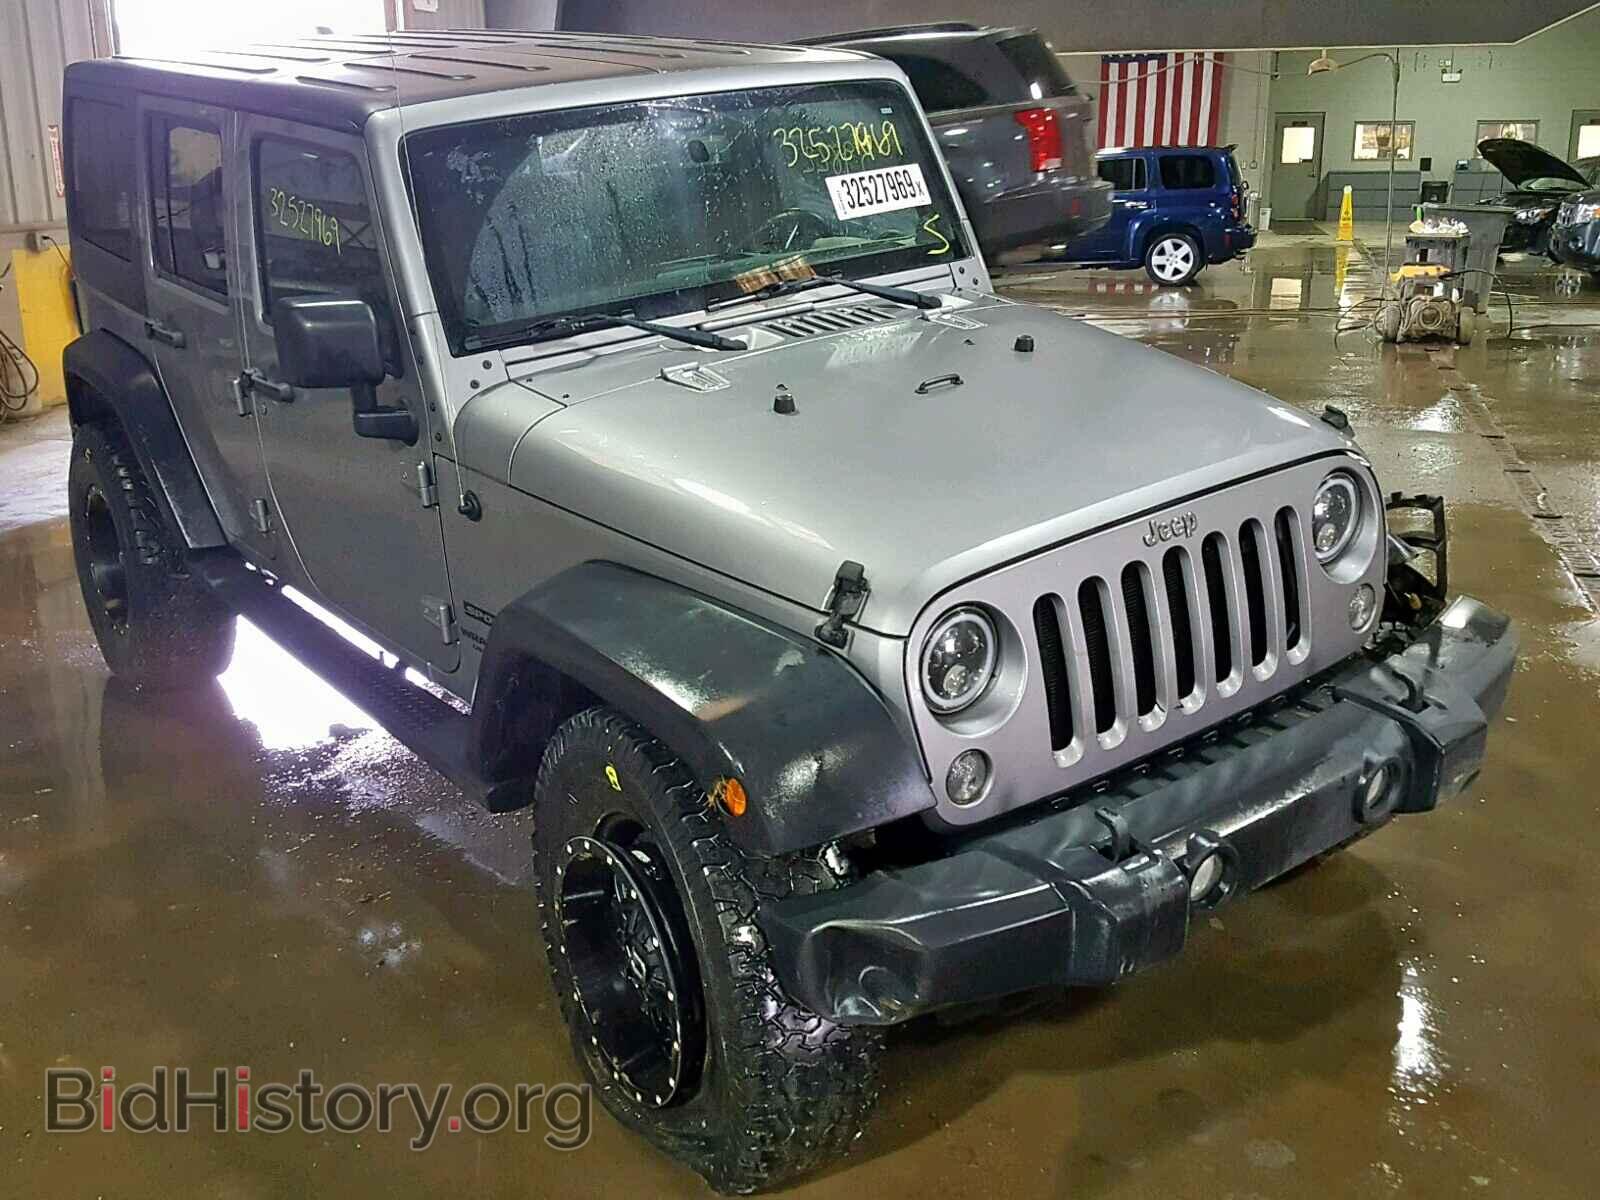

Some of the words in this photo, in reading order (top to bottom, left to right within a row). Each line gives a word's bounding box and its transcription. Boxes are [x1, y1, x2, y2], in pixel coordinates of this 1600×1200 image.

[841, 169, 916, 209] 32527969
[270, 187, 341, 256] 32527969
[1142, 511, 1198, 548] Jeep
